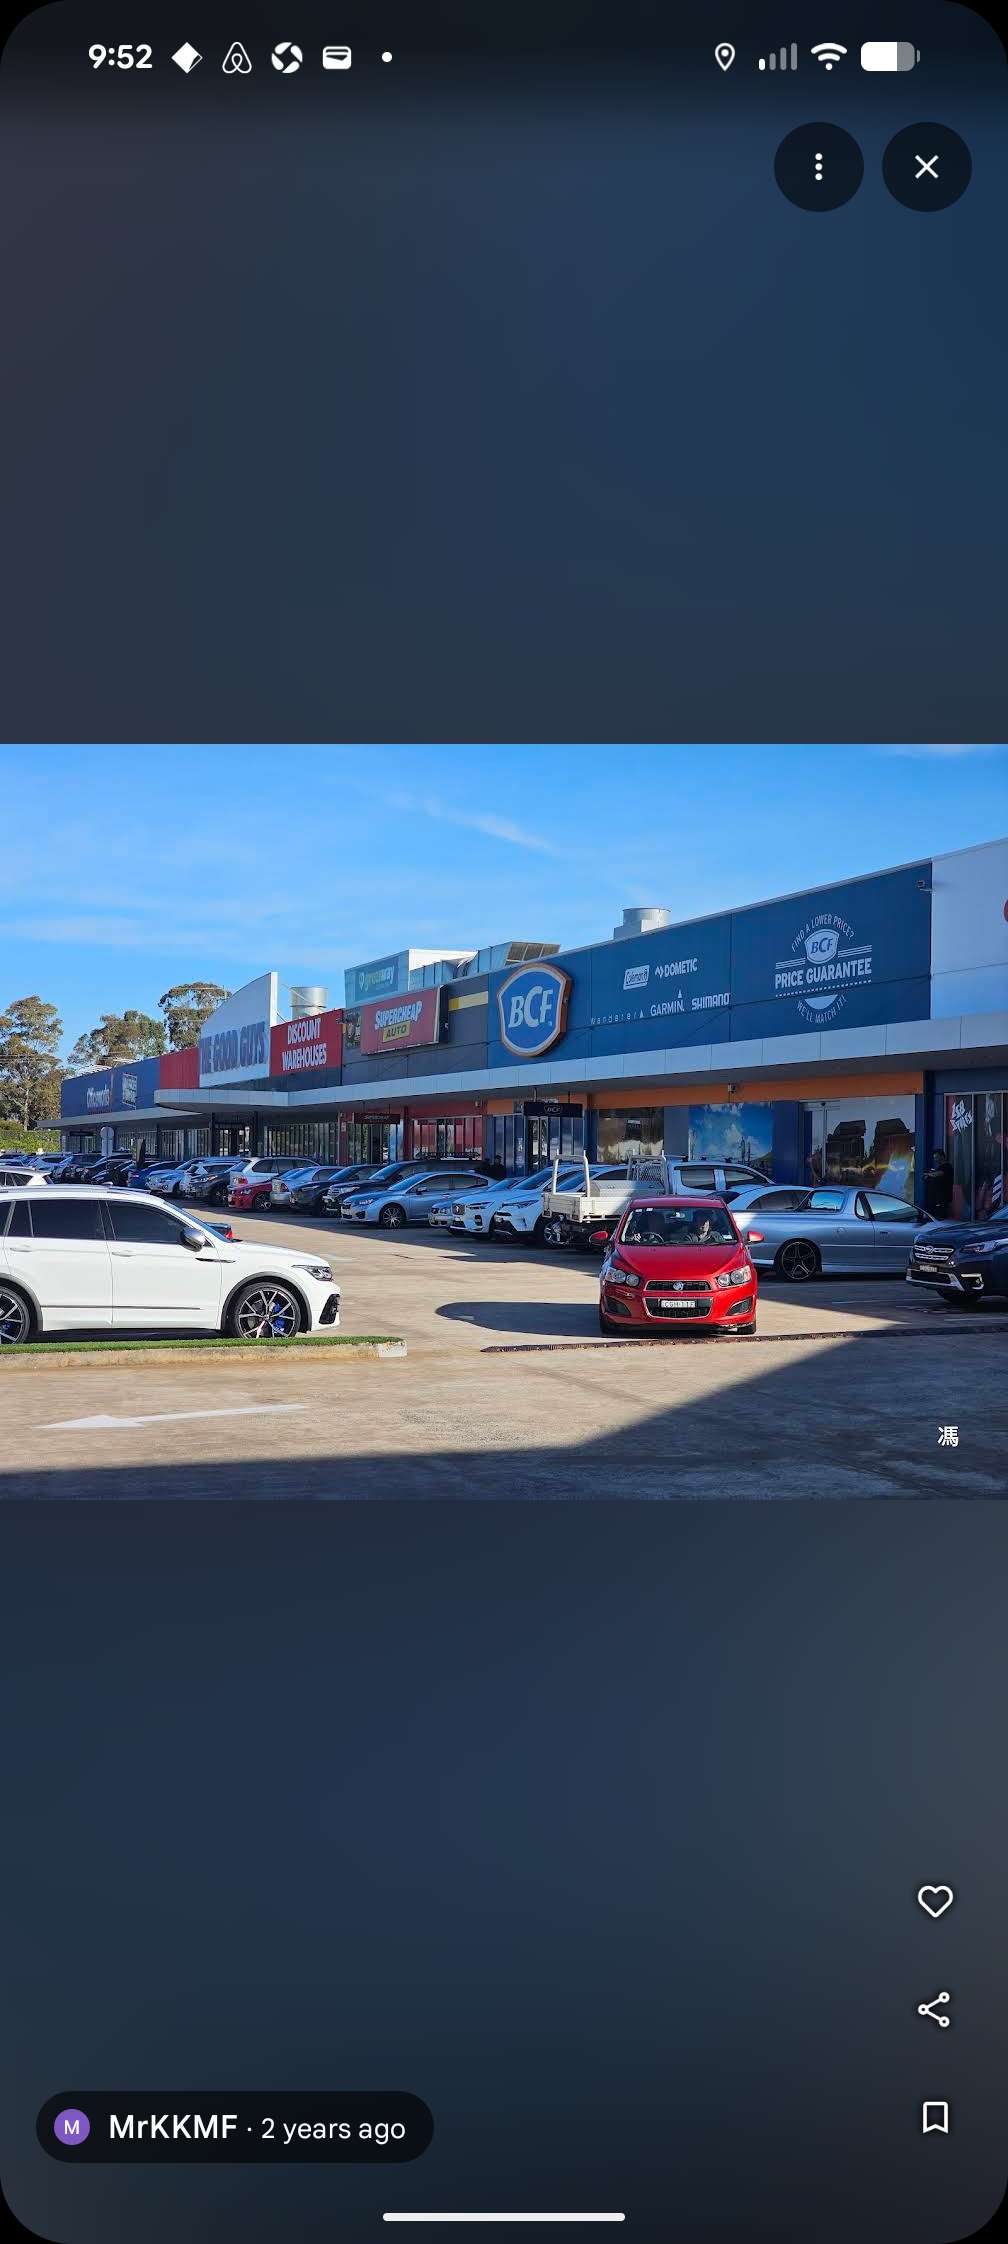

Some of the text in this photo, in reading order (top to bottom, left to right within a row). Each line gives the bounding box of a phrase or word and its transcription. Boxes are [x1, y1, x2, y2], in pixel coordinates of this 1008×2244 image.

[811, 913, 832, 929] LOWER
[810, 937, 833, 954] BCF
[664, 957, 698, 978] DOMETIC
[775, 957, 872, 989] PRICE GUARANTEE
[508, 985, 555, 1029] BCF
[650, 999, 685, 1017] GARMIN
[691, 992, 731, 1011] SHIMANO
[374, 1000, 423, 1030] SUPERCHEAP
[287, 1017, 321, 1045] DISCOUNT
[385, 1024, 408, 1039] AUTO
[282, 1042, 327, 1071] WAREHOUSES
